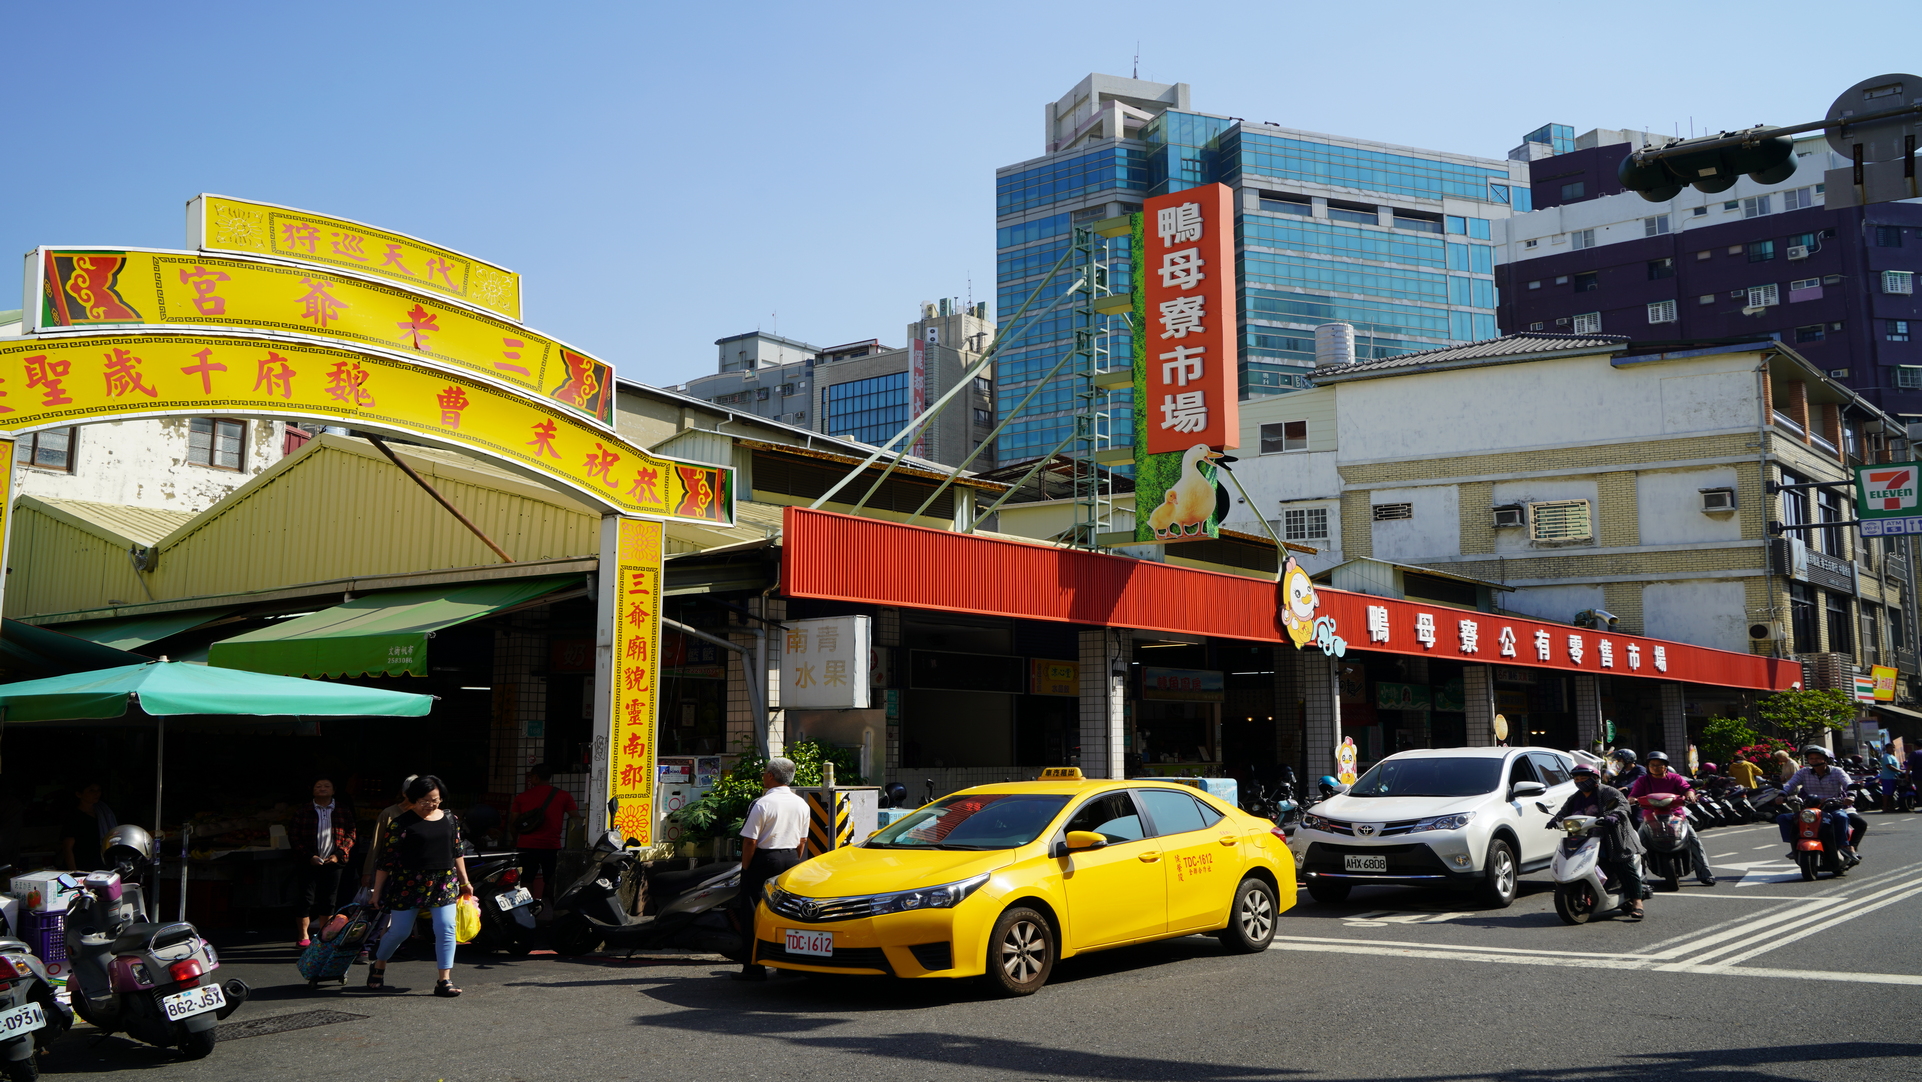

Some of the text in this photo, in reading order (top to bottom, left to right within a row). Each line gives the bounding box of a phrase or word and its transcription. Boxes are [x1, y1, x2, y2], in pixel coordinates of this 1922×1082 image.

[1156, 202, 1209, 434] 鴨母寮市場
[1366, 605, 1667, 672] 鴨母寮公有零售市場
[619, 573, 650, 790] 三爺廟貌靈南郡
[795, 660, 847, 688] 水果
[1183, 853, 1213, 868] TDC-1612
[1346, 858, 1386, 869] AHX-6808
[786, 934, 832, 953] TDC-1612
[168, 989, 224, 1017] 862-JSX
